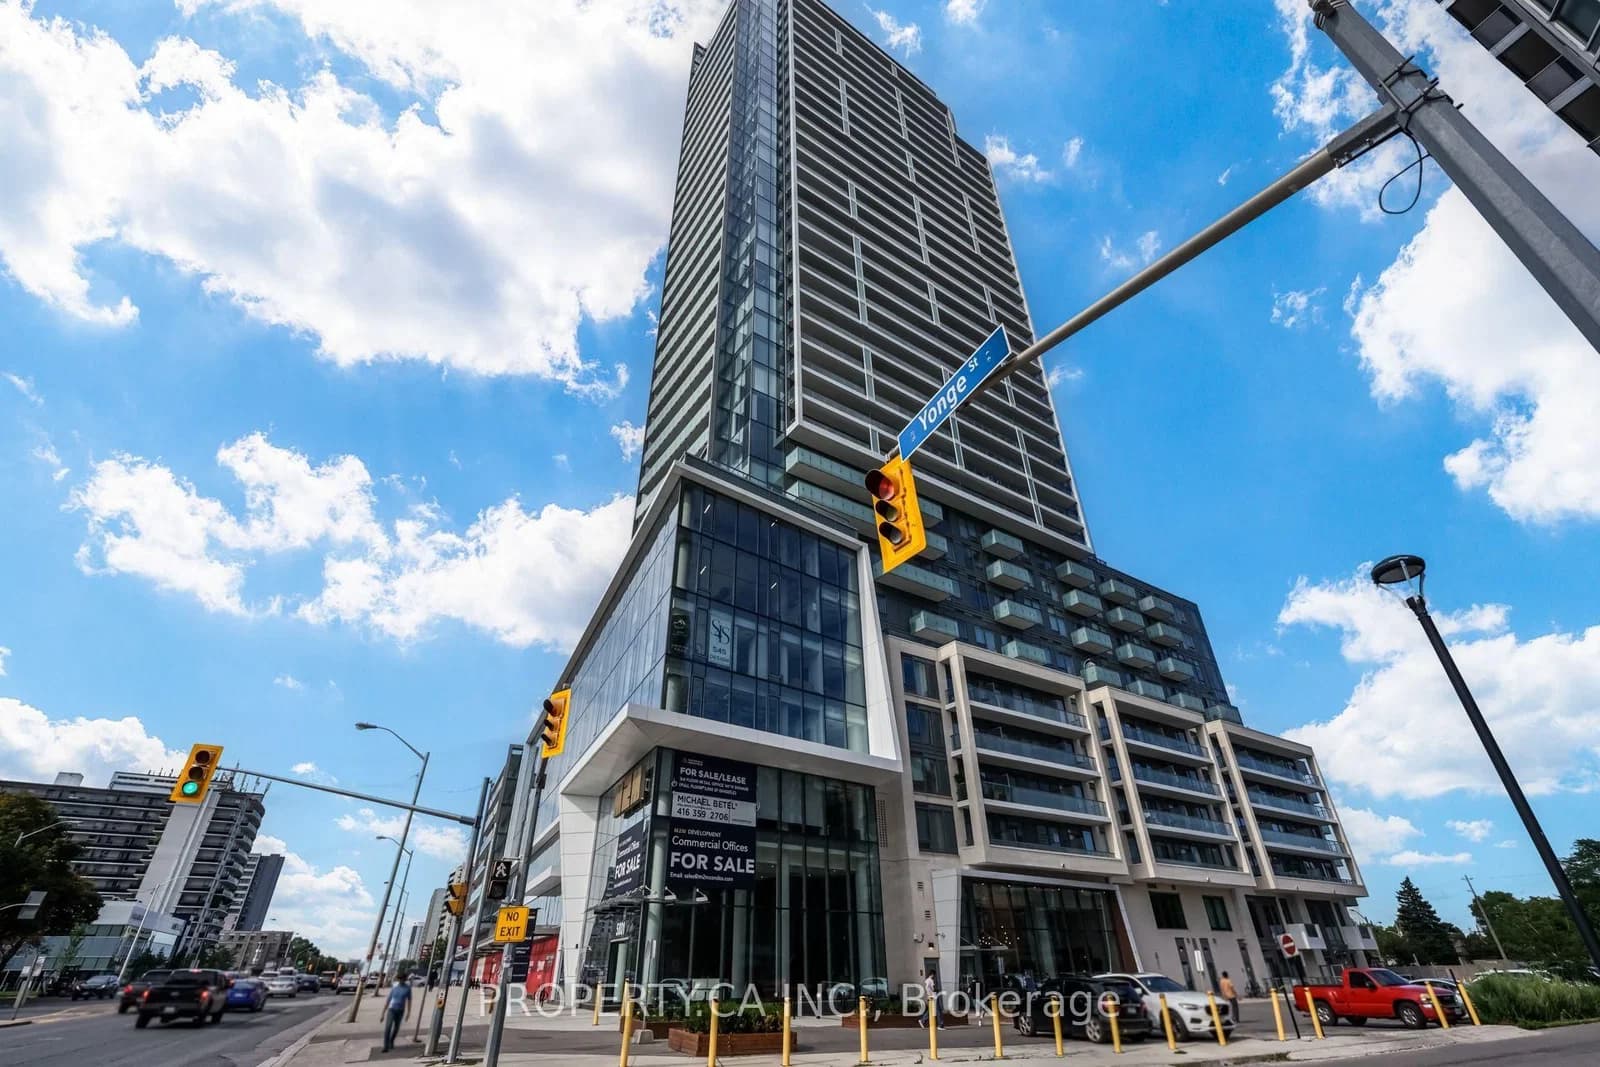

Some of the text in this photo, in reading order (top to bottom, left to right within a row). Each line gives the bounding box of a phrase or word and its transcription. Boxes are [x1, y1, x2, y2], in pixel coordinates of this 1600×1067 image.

[918, 375, 967, 431] Yonge
[680, 767, 697, 777] FOR
[698, 770, 747, 785] SALE/LEASE
[677, 795, 711, 807] MICHAEL
[677, 808, 729, 821] 416 359 2706
[687, 829, 722, 838] DEVELOPMENT
[672, 835, 749, 853] Commercial Offices
[615, 853, 641, 880] FOR SALE
[670, 852, 755, 874] FOR SALE
[506, 911, 520, 922] NO
[500, 926, 521, 937] EXIT
